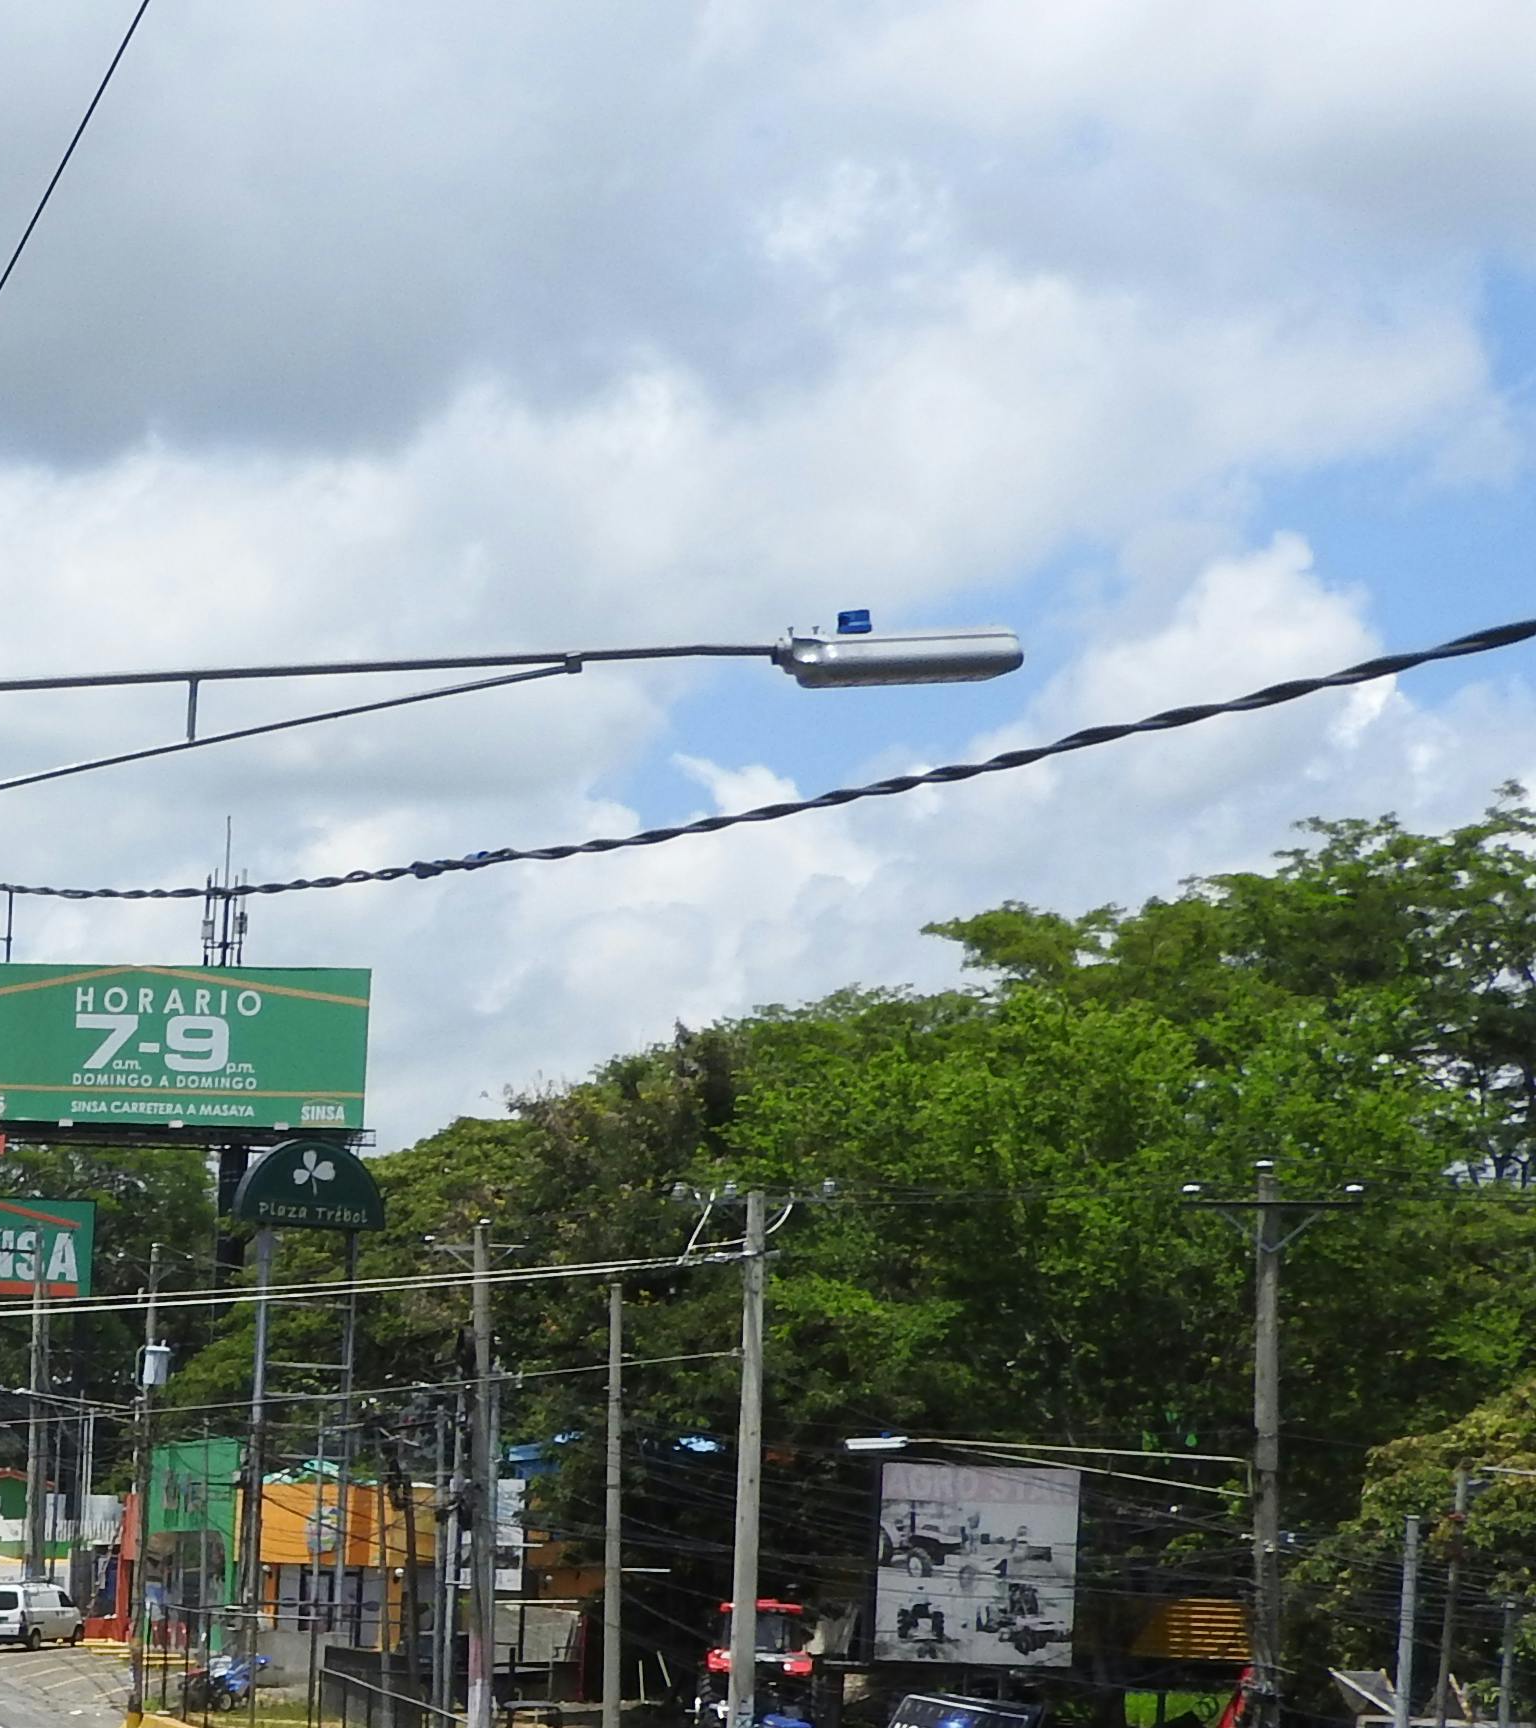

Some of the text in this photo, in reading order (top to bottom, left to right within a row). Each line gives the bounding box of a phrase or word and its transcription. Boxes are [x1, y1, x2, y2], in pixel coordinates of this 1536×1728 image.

[75, 986, 263, 1017] HORARIO
[112, 1058, 255, 1075] a.m. p.m.
[72, 1073, 258, 1090] DOMINGO A DOMINGO
[70, 1100, 255, 1117] SINSA CARRETERA A MASAYA
[300, 1105, 346, 1122] SINSA
[258, 1201, 369, 1223] Plaza Trébol
